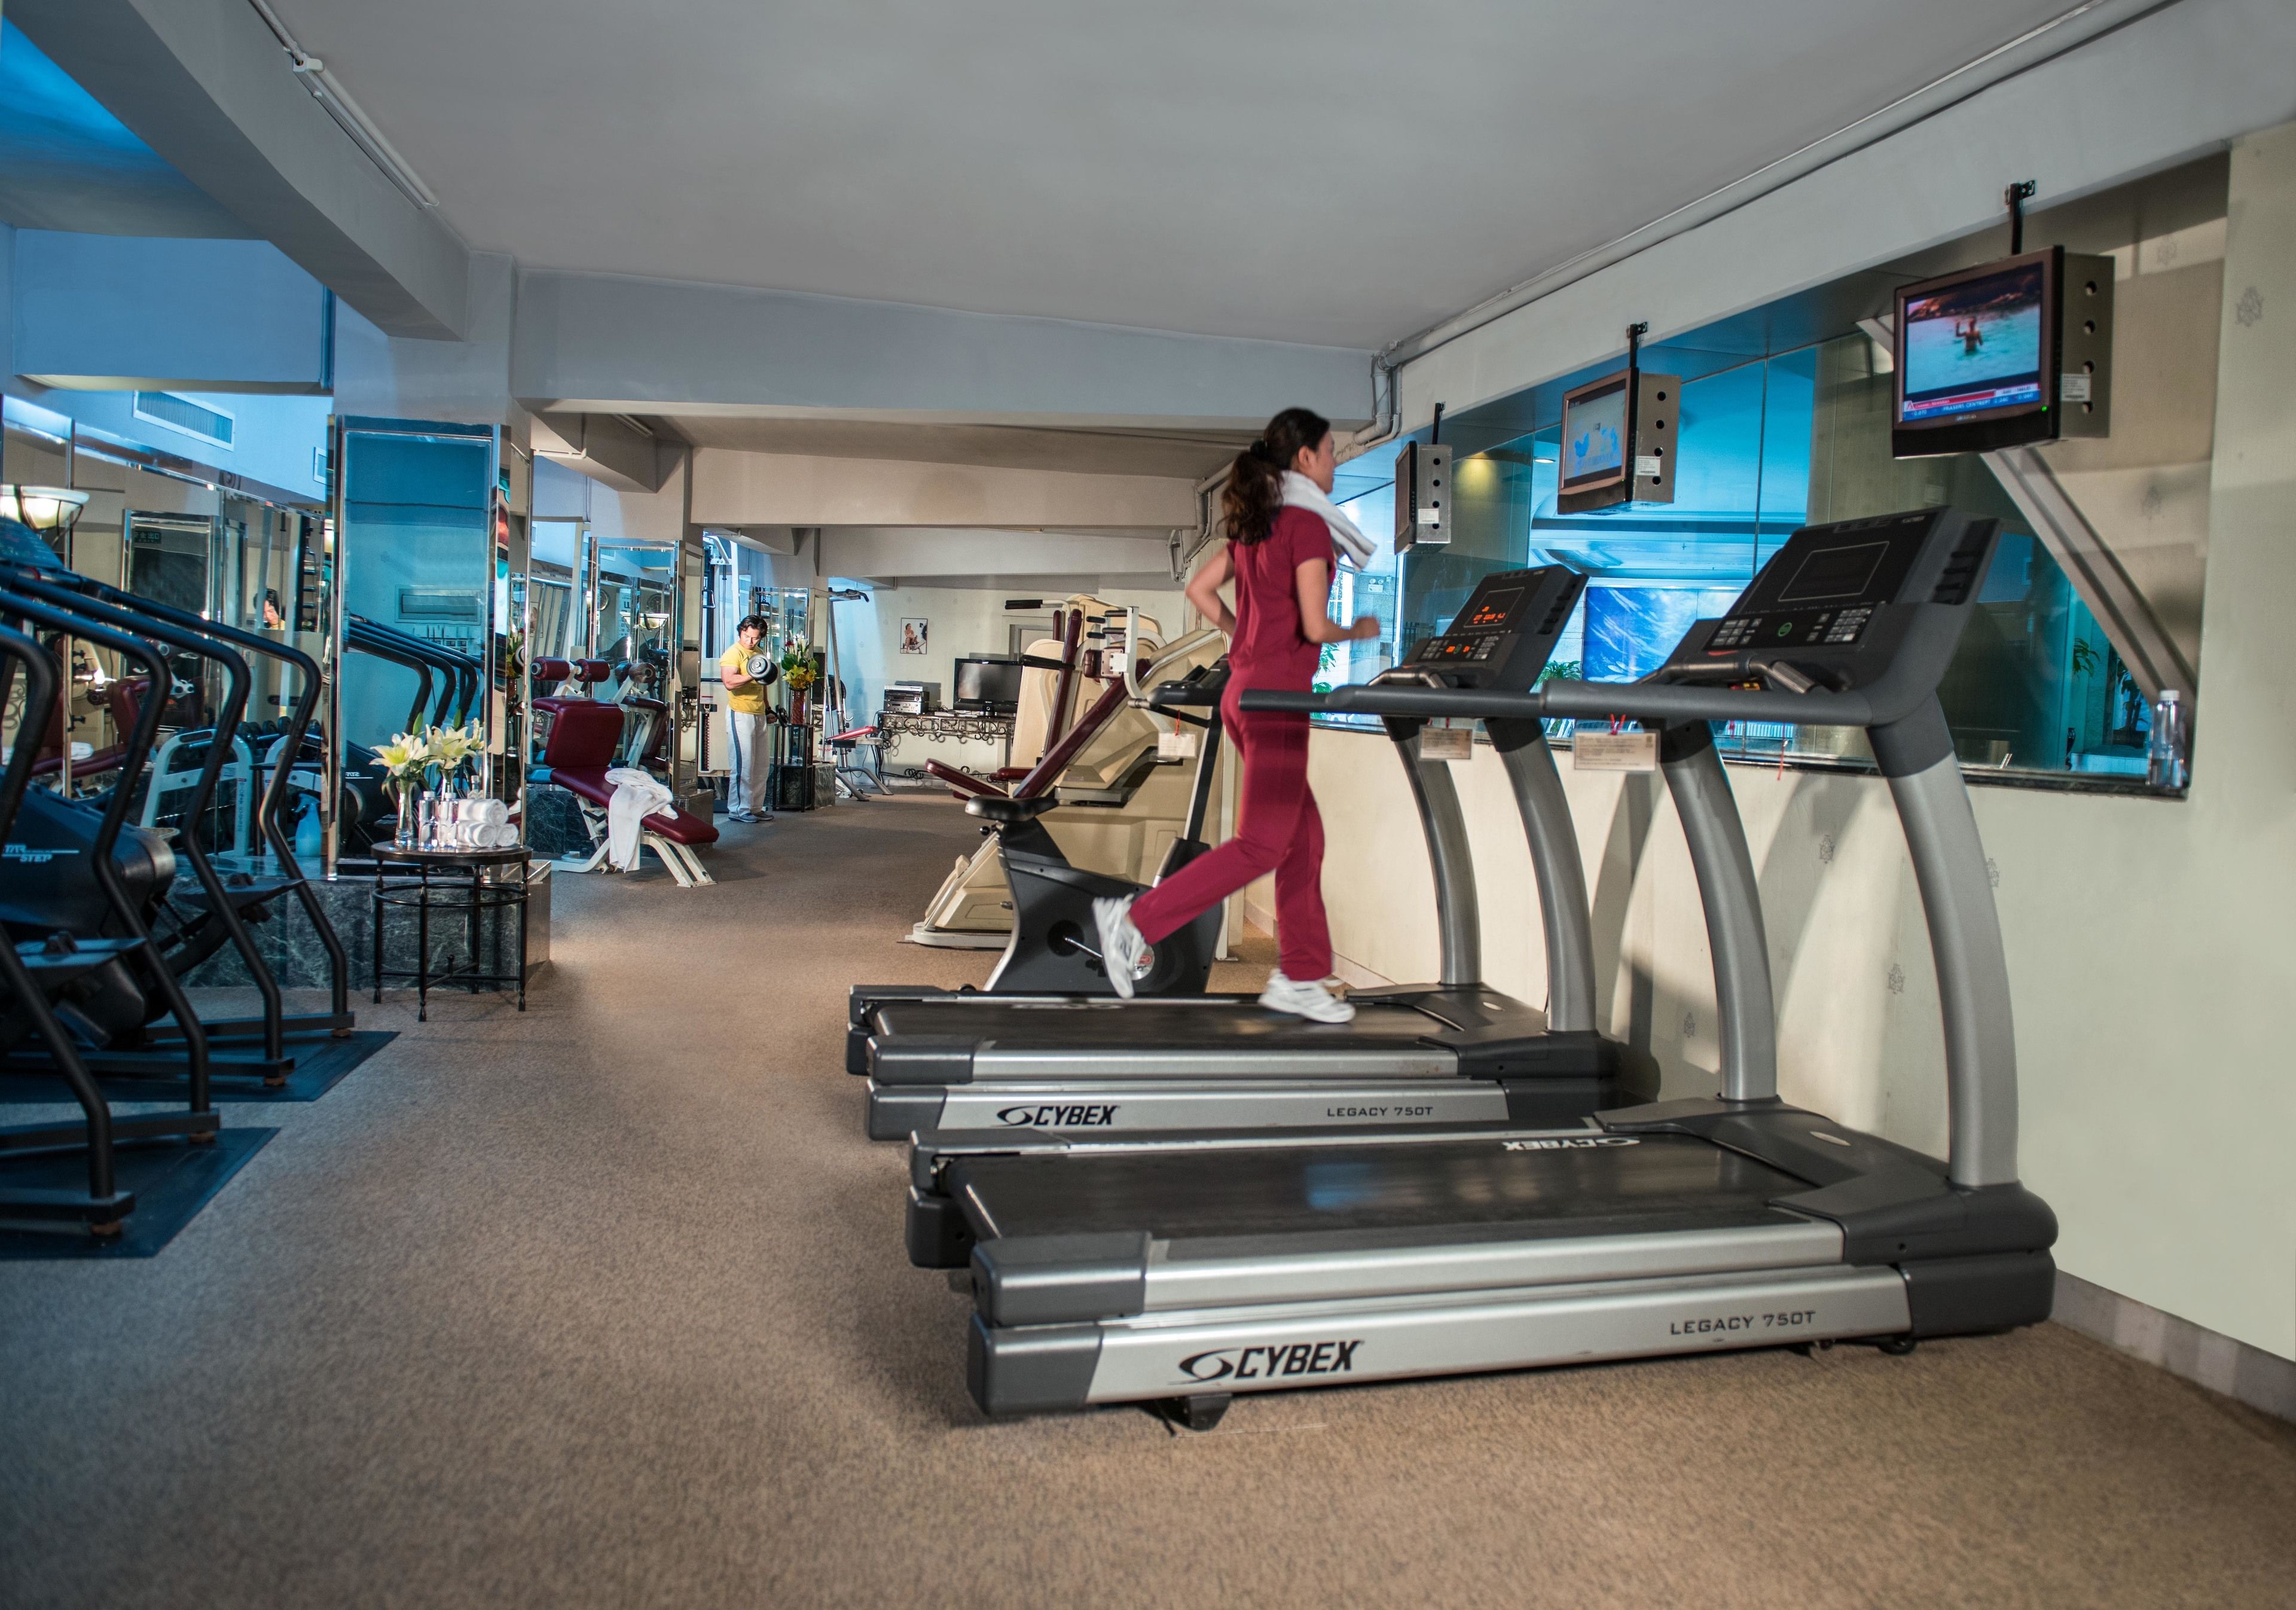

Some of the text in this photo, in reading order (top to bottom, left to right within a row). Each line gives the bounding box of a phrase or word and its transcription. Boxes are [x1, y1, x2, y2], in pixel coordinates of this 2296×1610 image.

[20, 853, 53, 862] STEP
[1034, 1105, 1118, 1126] CYBEX
[1327, 1106, 1433, 1117] LEGACY 750T
[1502, 1139, 1597, 1151] CYBEX
[1671, 1310, 1816, 1335] LEGACY 750T
[1235, 1340, 1362, 1379] CYBEX
